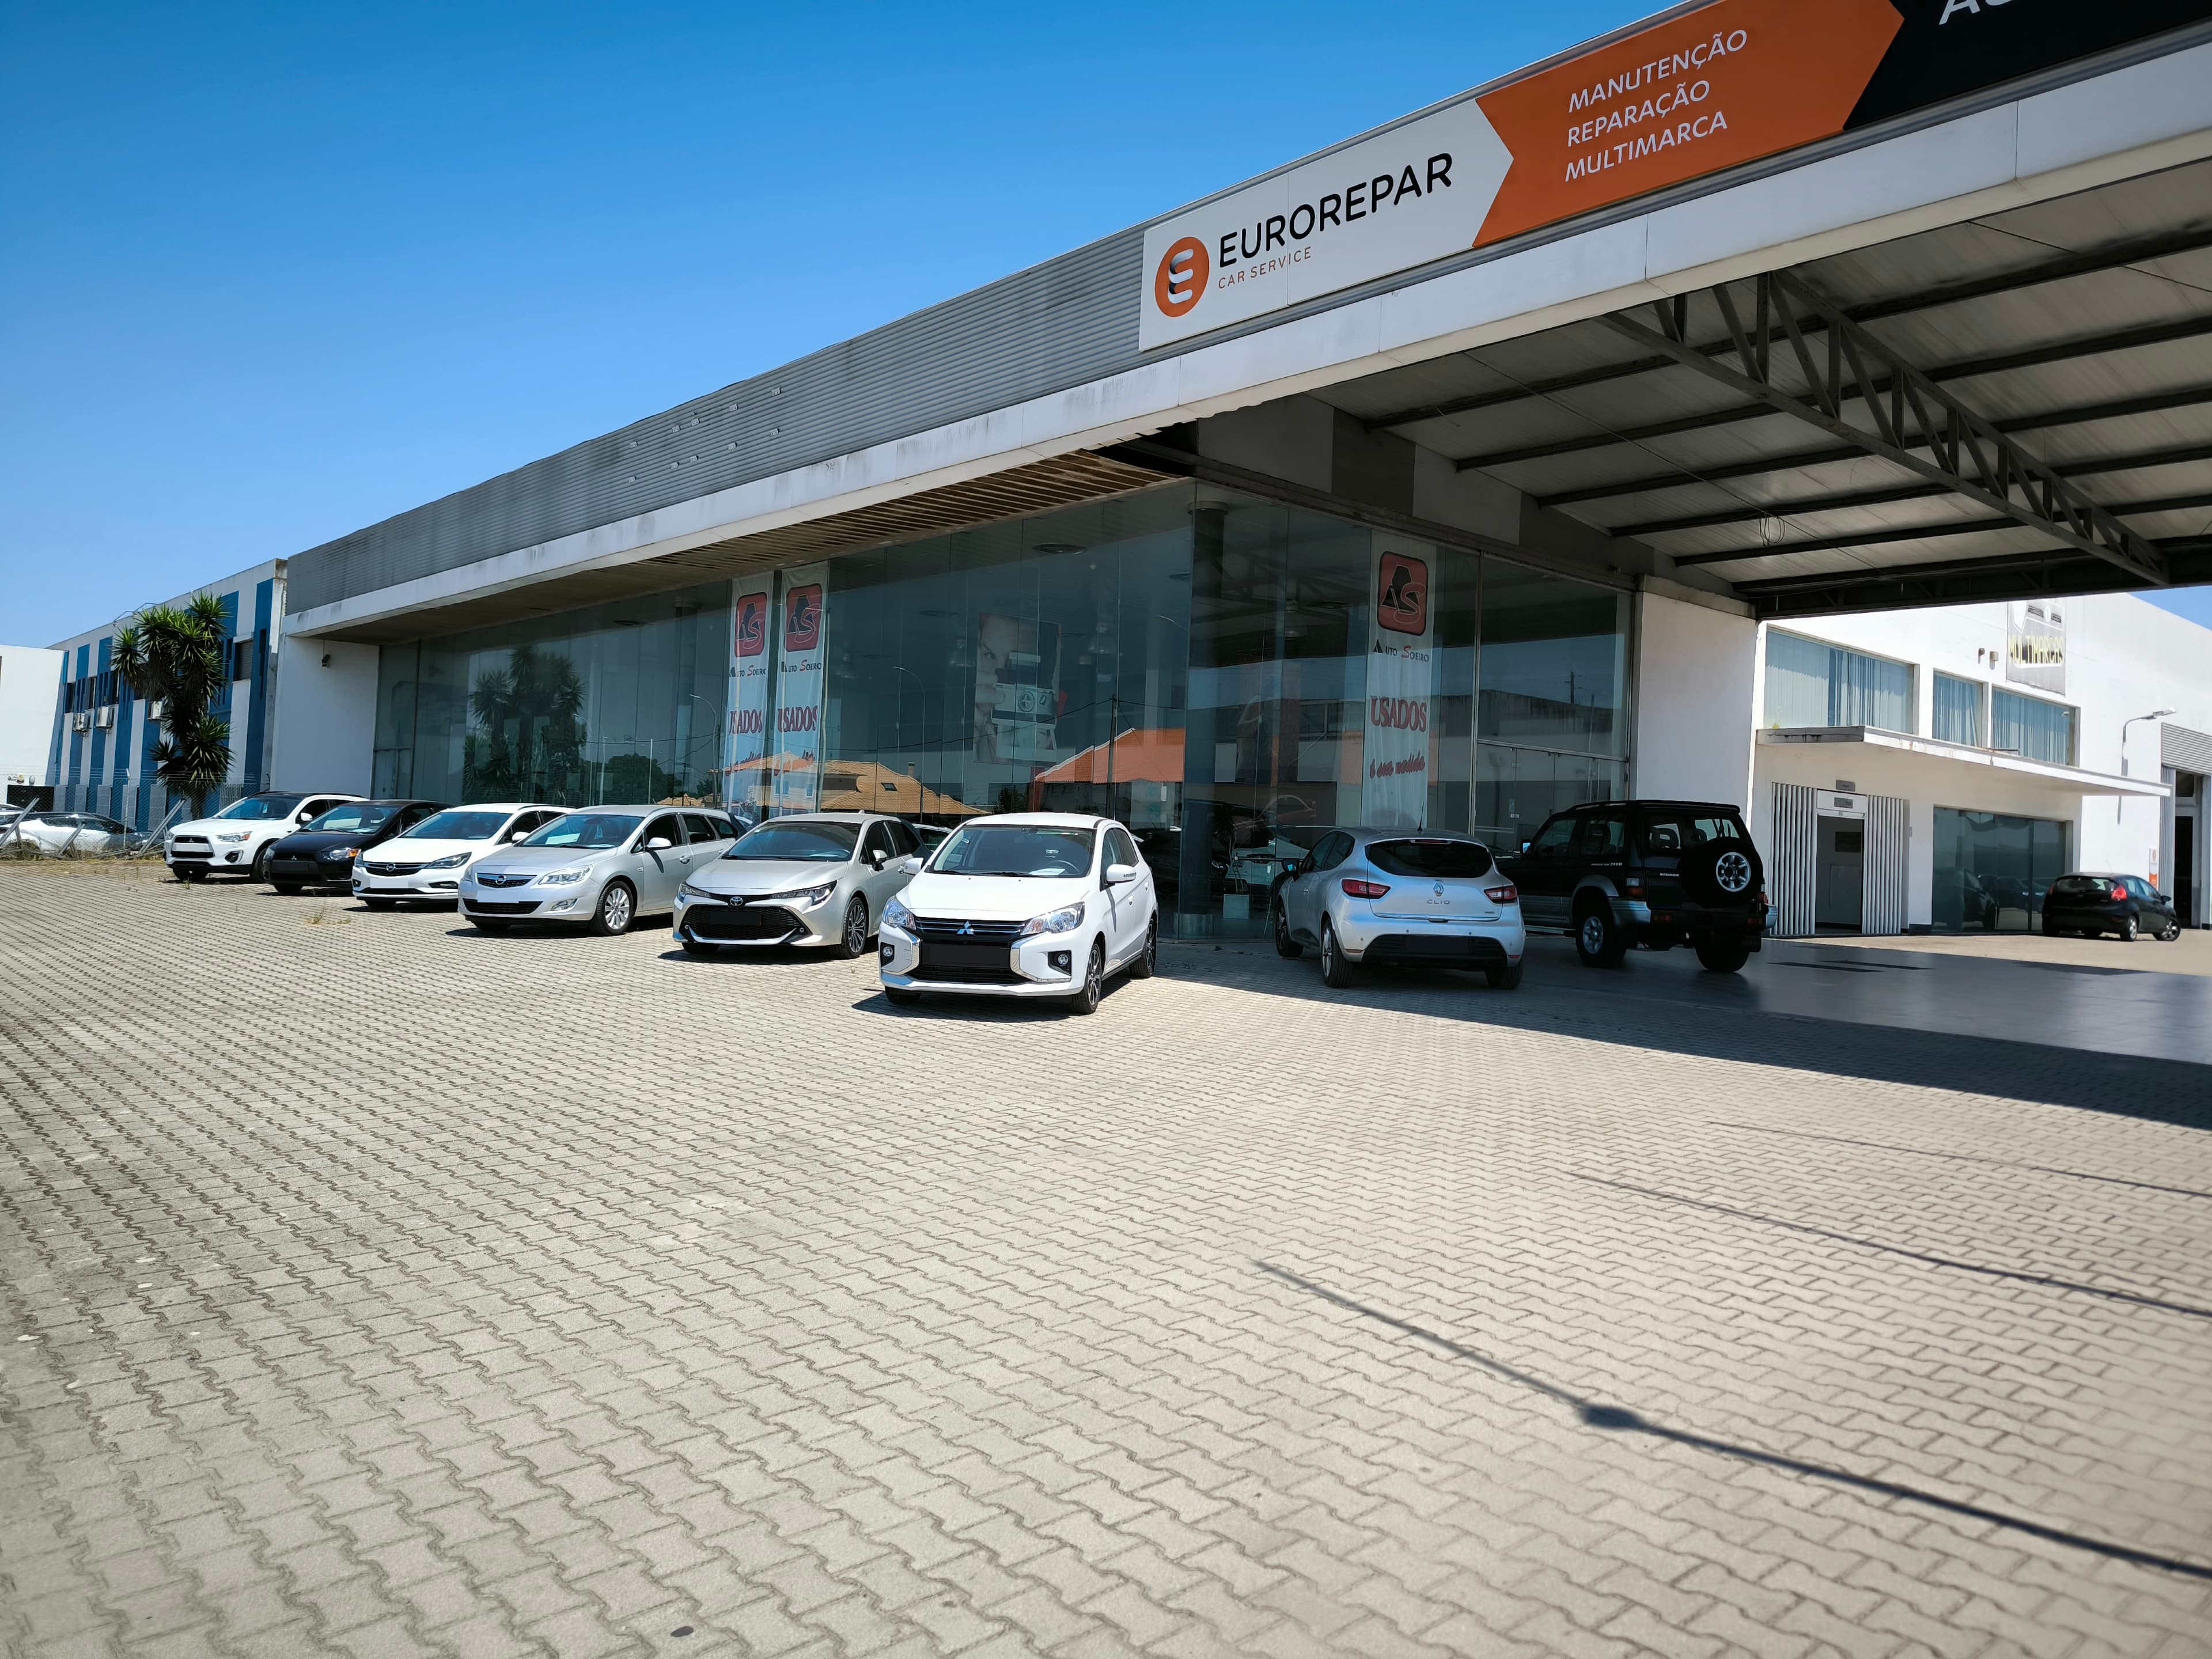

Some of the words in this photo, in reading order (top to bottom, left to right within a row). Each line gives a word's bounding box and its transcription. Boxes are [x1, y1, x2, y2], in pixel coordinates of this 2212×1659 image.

[1939, 0, 2012, 25] A
[1568, 29, 1748, 113] MANUTENÇÃO
[1567, 79, 1710, 147] REPARAÇÃO
[1565, 111, 1728, 183] MULTIMARCA
[1219, 153, 1453, 268] EUROREPAR
[1218, 270, 1245, 289] CAR
[1250, 246, 1312, 279] SERVICE
[1373, 639, 1397, 656] AUTO
[1401, 645, 1430, 662] SOEIRO
[2009, 635, 2065, 664] MULTIMARCAS
[777, 705, 818, 733] USADOS
[1370, 695, 1427, 732] USADOS
